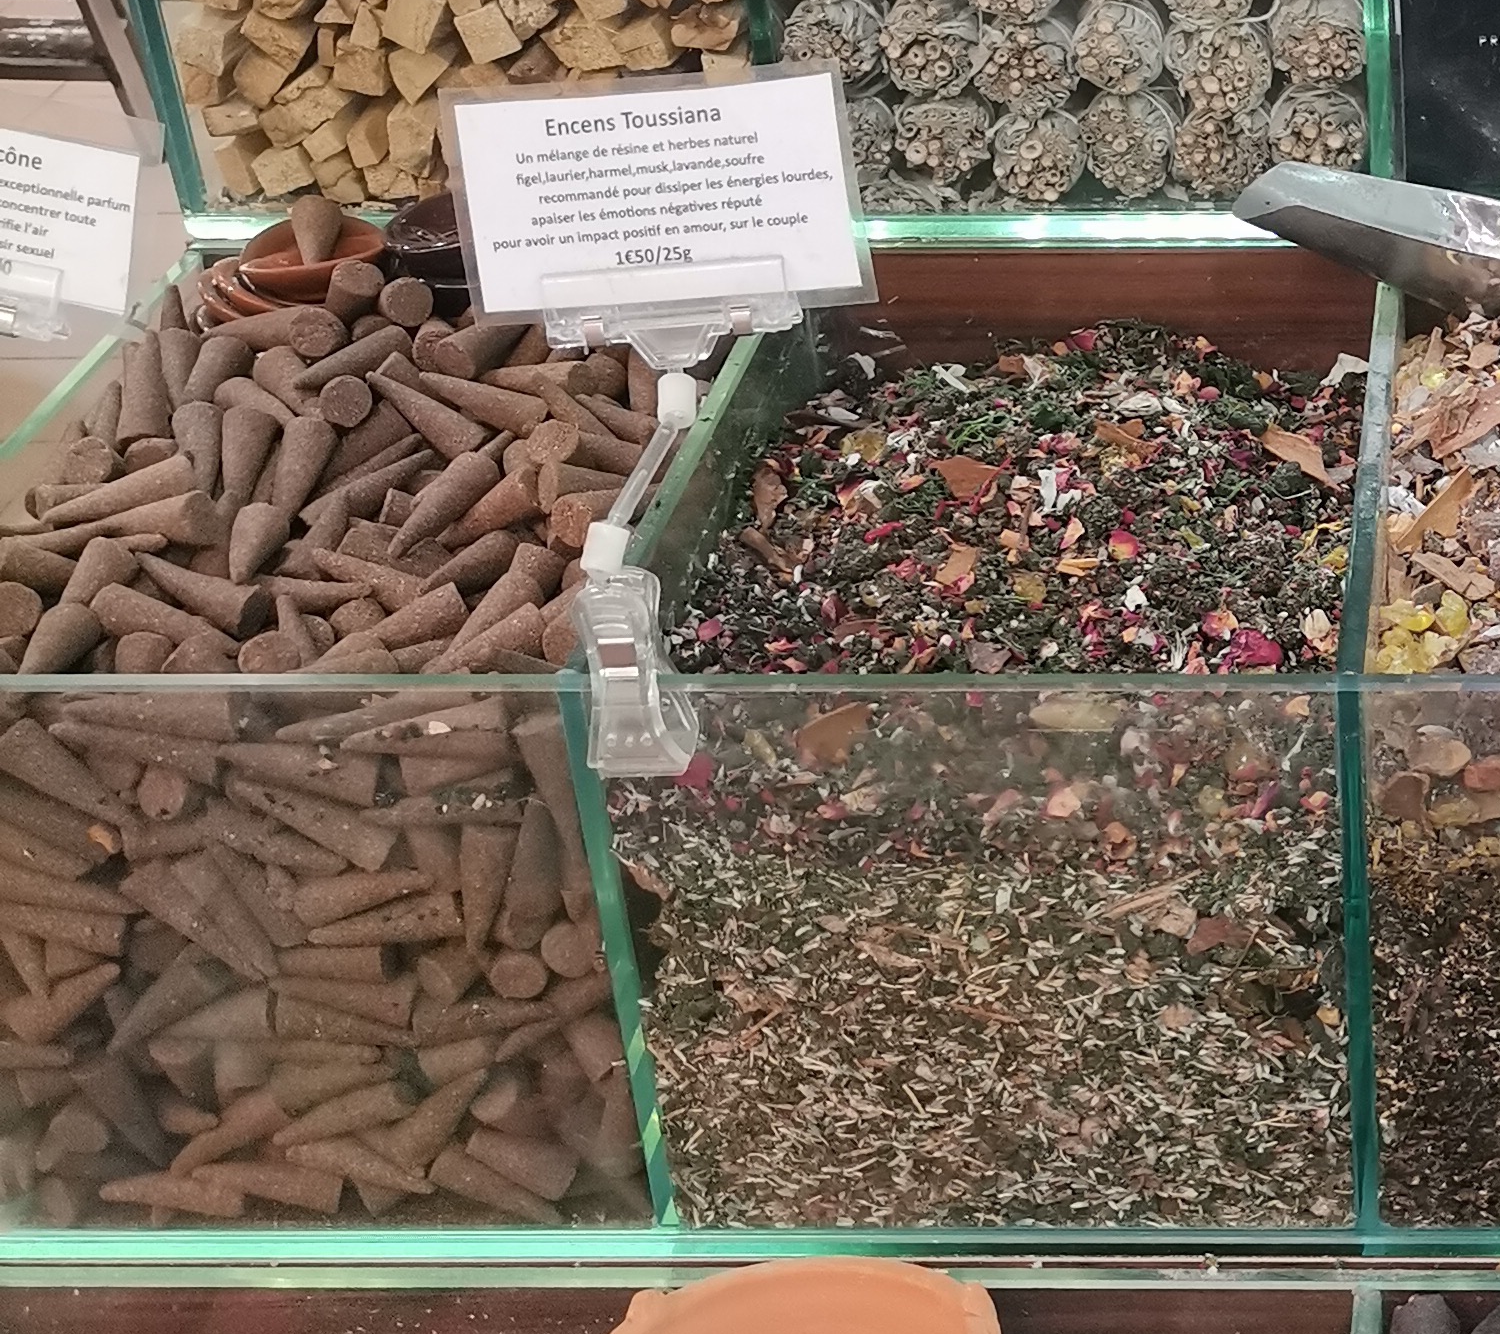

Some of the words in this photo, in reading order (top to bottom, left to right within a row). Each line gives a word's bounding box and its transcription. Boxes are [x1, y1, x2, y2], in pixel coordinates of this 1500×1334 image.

[545, 117, 616, 137] Encens
[620, 105, 722, 130] Toussiana
[515, 152, 534, 165] Un
[536, 149, 590, 163] mélange
[592, 145, 609, 158] de
[611, 143, 649, 156] résine
[652, 141, 665, 153] et
[667, 137, 711, 151] herbes
[713, 131, 759, 147] naturel
[87, 196, 131, 212] parfum
[65, 211, 97, 227] toute
[16, 243, 55, 258] sexuel
[615, 245, 693, 268] 1€50/25g
